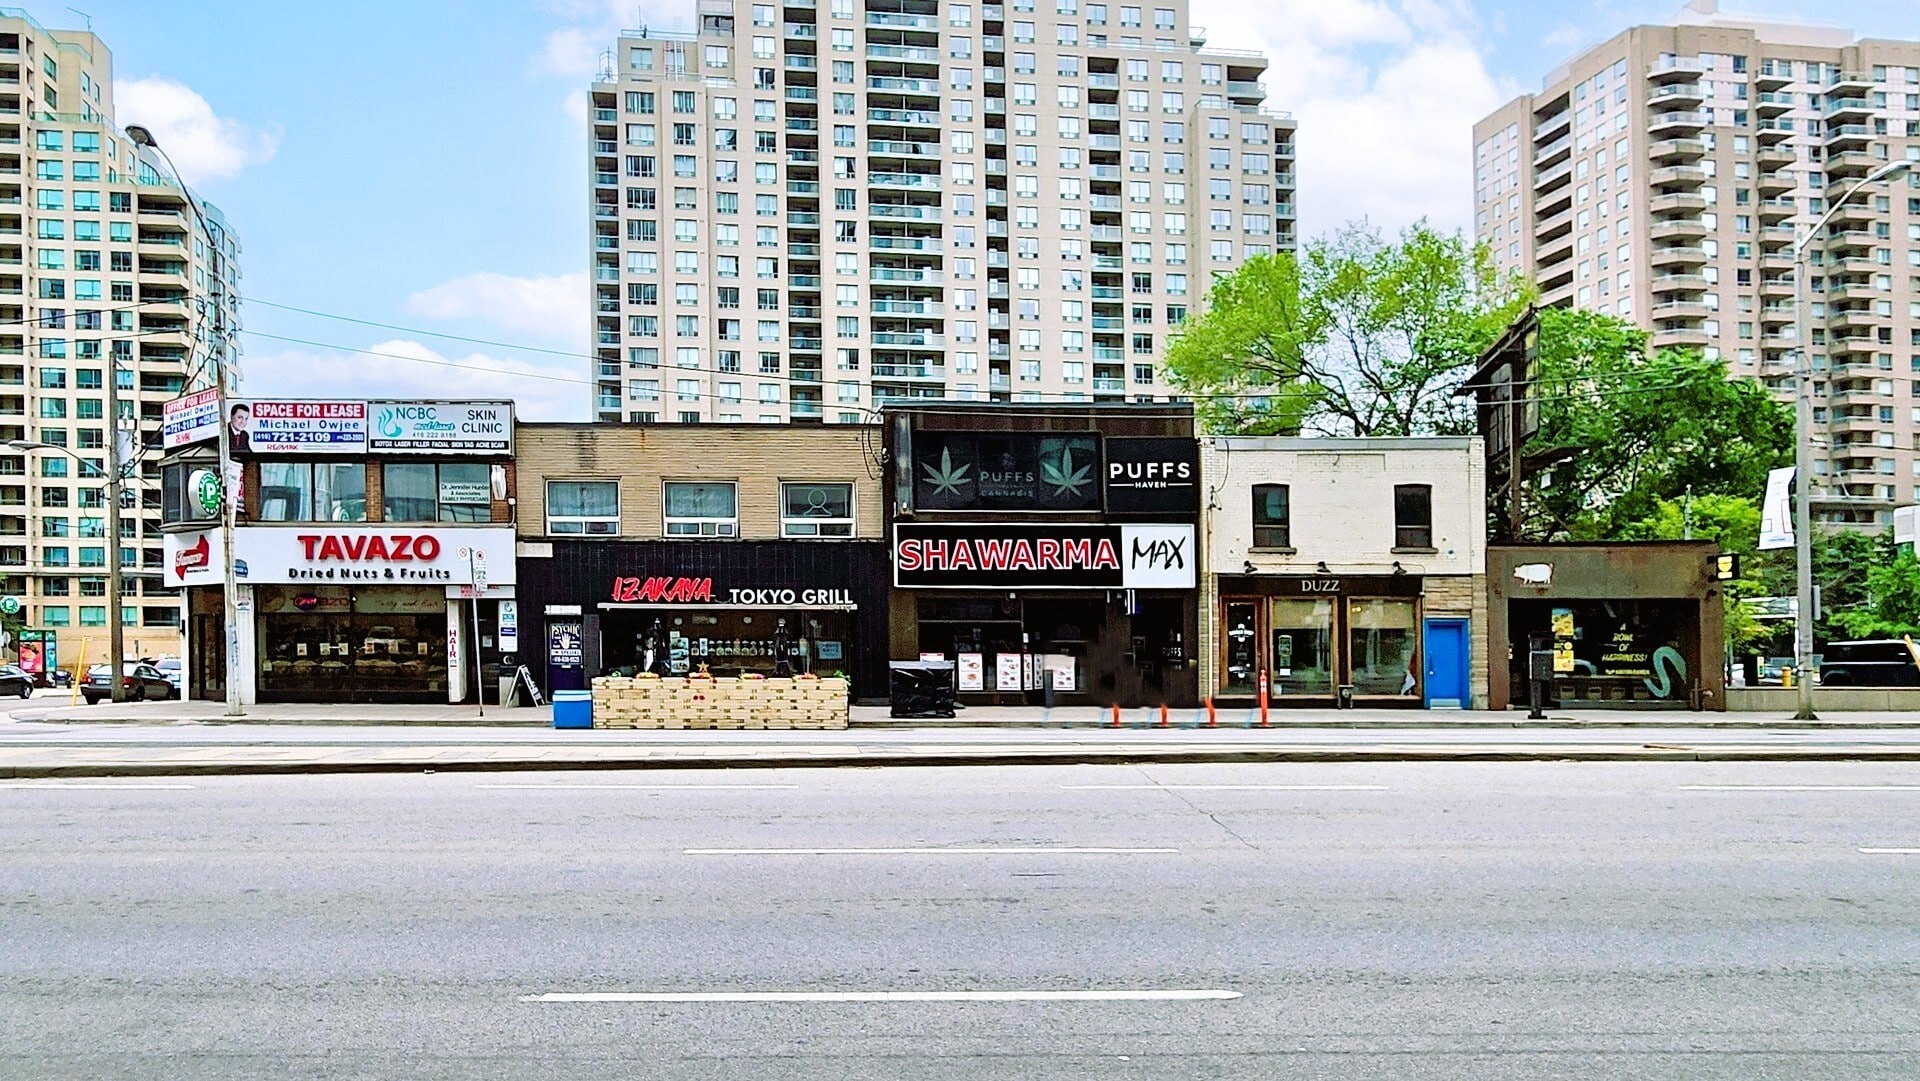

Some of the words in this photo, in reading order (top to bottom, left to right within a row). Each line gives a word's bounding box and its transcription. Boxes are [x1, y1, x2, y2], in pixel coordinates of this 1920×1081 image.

[186, 395, 199, 407] FOR
[200, 390, 218, 404] LEASE
[255, 403, 294, 417] SPACE
[297, 403, 321, 417] FOR
[323, 403, 362, 417] LEASE
[395, 407, 437, 420] NCBC
[467, 409, 497, 421] SKIN
[259, 419, 311, 429] Michael
[318, 419, 360, 431] Owjee
[461, 422, 504, 434] CLINIC
[272, 431, 331, 442] 721-2109
[394, 440, 411, 448] LASER
[980, 471, 1034, 482] PUFFS
[1109, 462, 1190, 479] PUFFS
[206, 482, 216, 500] P
[1134, 481, 1167, 489] HAVEN
[297, 534, 441, 561] TAVAZO
[1131, 536, 1186, 570] MAX
[899, 538, 1120, 571] SHAWARMA
[288, 567, 335, 579] Dried
[340, 567, 378, 580] Nuts
[383, 567, 395, 579] &
[400, 567, 450, 580] Fruits
[612, 576, 713, 602] IZAKAYA
[1301, 580, 1340, 592] DUZZ
[729, 588, 795, 604] TOKYO
[802, 588, 853, 604] GRILL
[449, 629, 457, 658] HAIR
